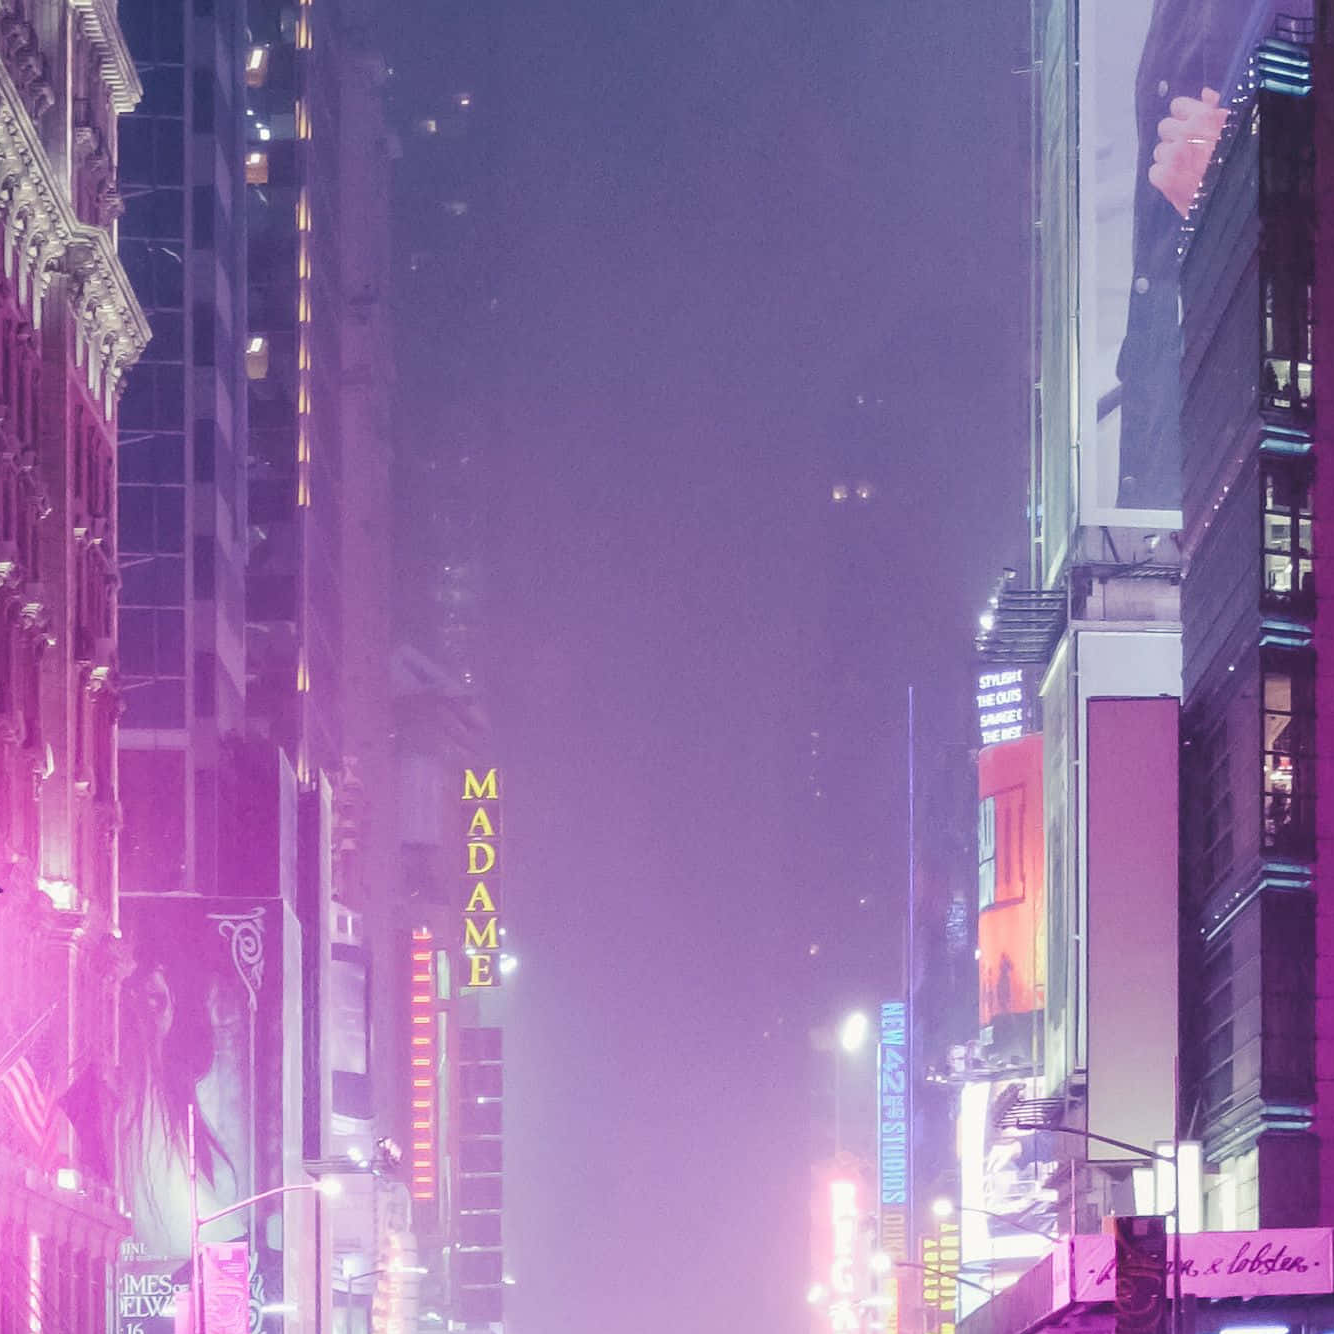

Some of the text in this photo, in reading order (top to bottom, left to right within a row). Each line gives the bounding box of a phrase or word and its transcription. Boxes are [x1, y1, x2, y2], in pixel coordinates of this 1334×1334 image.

[461, 768, 499, 987] MADAME
[881, 1002, 906, 1045] NEW
[881, 1121, 907, 1203] STUDIOS
[1226, 1241, 1309, 1277] lobster
